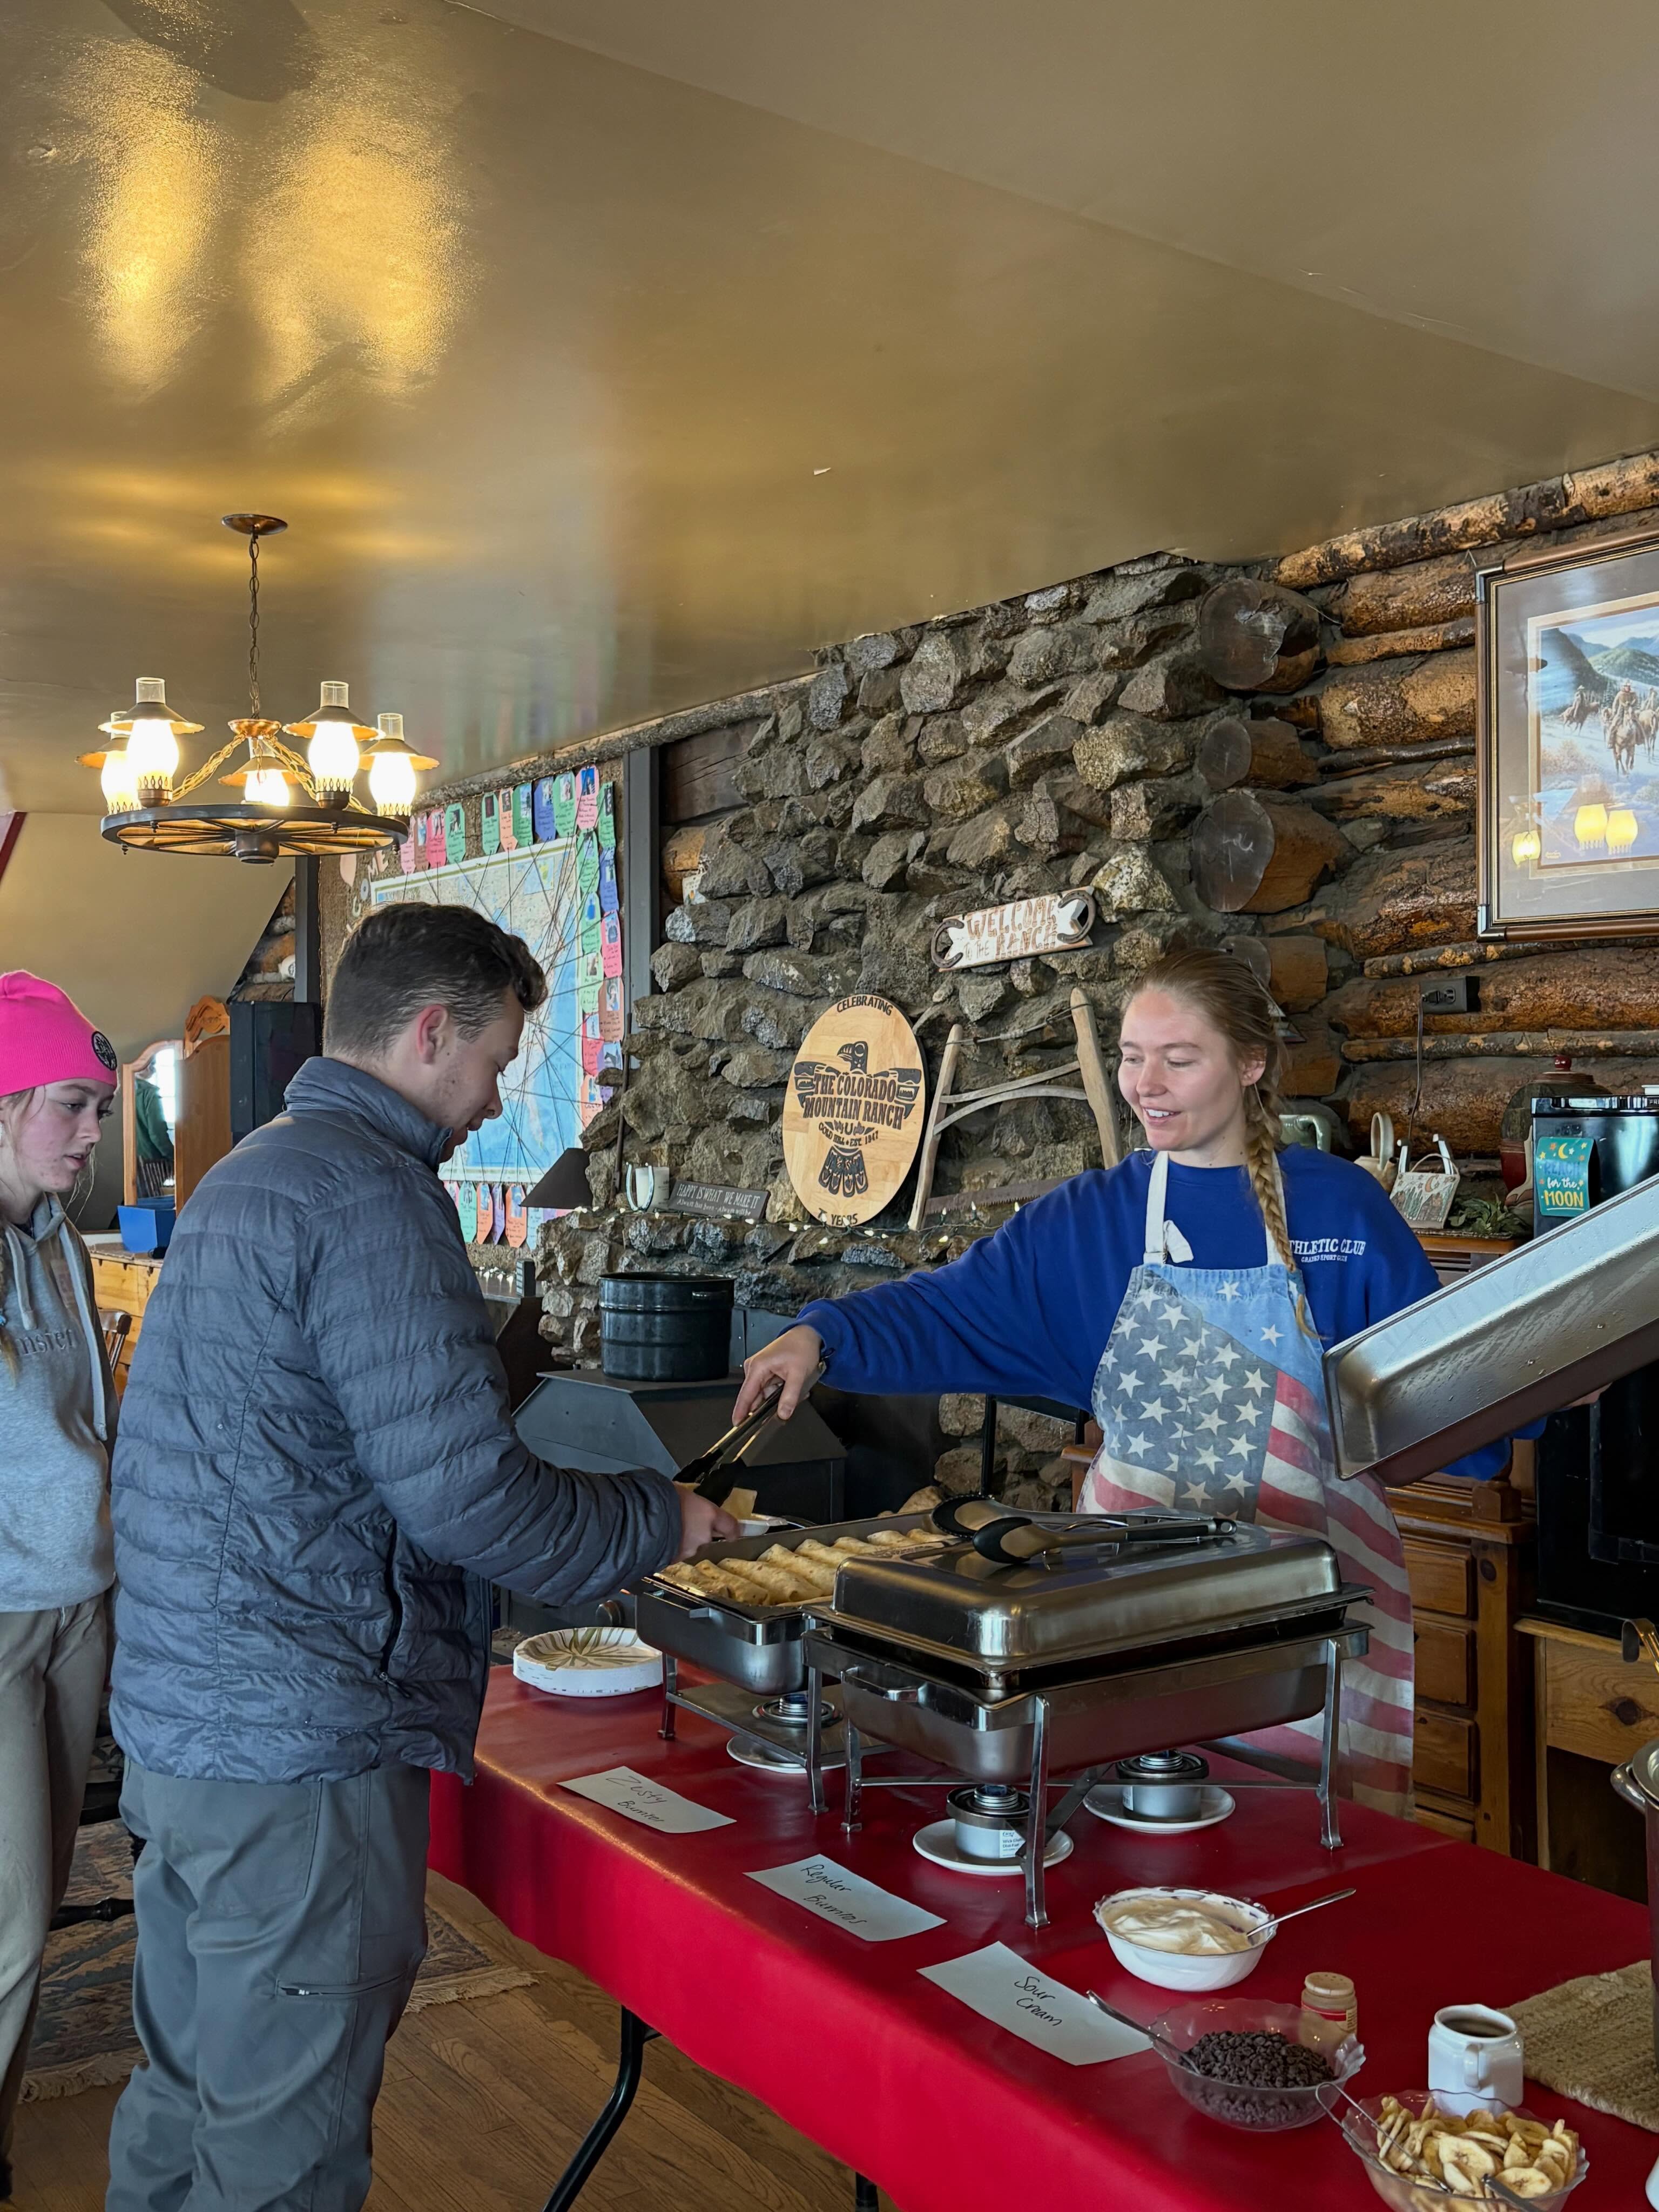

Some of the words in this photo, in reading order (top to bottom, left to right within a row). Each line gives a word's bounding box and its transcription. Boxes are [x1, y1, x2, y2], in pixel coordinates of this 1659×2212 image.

[966, 898, 1057, 939] WELCOME
[975, 940, 989, 959] THE
[996, 924, 1058, 960] RANCH
[837, 995, 893, 1016] CELEBRATING
[813, 1073, 835, 1096] THE
[837, 1074, 896, 1102] COLORADO
[802, 1095, 860, 1121] MOUNTAIN
[864, 1099, 905, 1130] RANCH
[819, 1122, 833, 1139] GOLD
[833, 1134, 845, 1145] HILL
[1544, 1162, 1580, 1175] REACH
[1547, 1177, 1561, 1189] for
[1562, 1178, 1577, 1188] the
[677, 1184, 697, 1198] HAPPY
[696, 1186, 705, 1199] IS
[703, 1188, 723, 1202] WHAT
[724, 1191, 734, 1205] WE
[733, 1193, 752, 1208] MAKE
[750, 1196, 760, 1209] IT
[1544, 1190, 1583, 1207] MOON
[1290, 1238, 1339, 1255] THLETIC
[1340, 1239, 1366, 1256] CLUB
[800, 1864, 852, 1892] Regular
[1014, 1977, 1056, 1999] Sour
[1016, 1998, 1063, 2026] Cream
